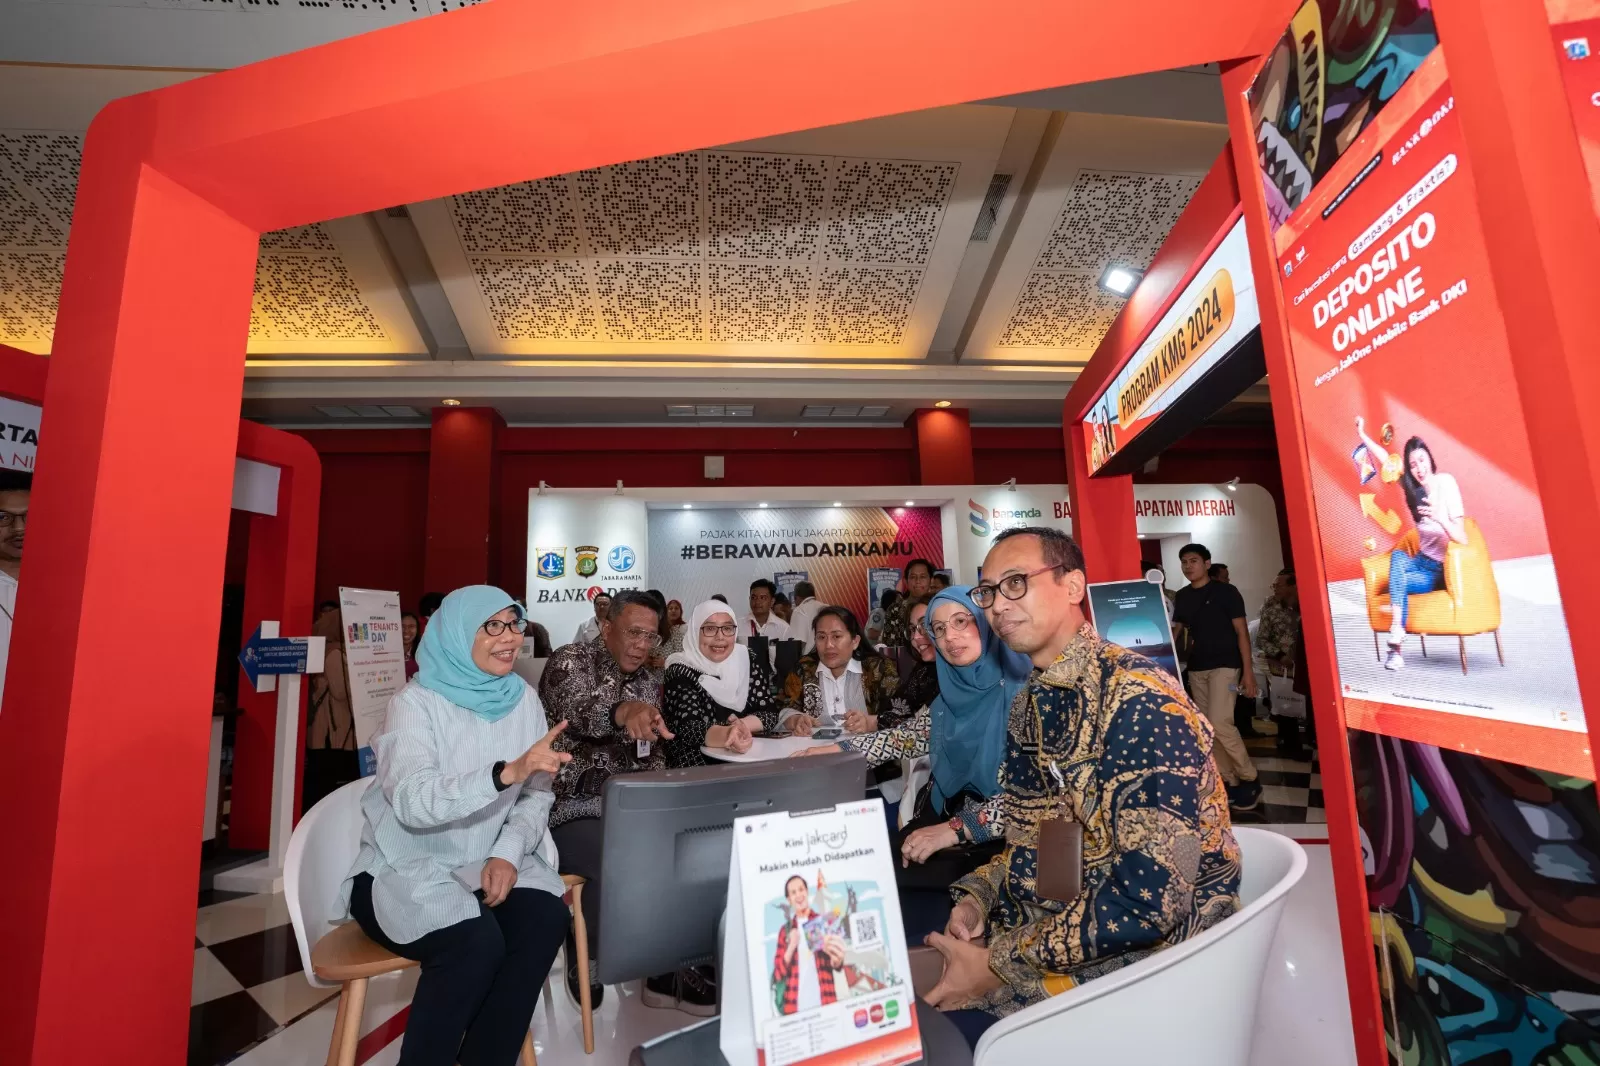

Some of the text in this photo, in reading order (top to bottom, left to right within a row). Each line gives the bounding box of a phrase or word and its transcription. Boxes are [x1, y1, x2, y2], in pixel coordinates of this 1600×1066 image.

[1351, 213, 1395, 255] Gampang
[1312, 212, 1436, 329] DEPOSITO
[1331, 265, 1426, 352] ONLINE
[1372, 321, 1408, 350] Mobile
[1408, 299, 1441, 327] Bank
[1441, 279, 1468, 306] DKI
[1121, 287, 1222, 421] PROGRAM KMG 2024
[992, 507, 1041, 521] bapenda
[1135, 499, 1183, 518] APATAN
[1186, 499, 1236, 517] DAERAH
[700, 527, 896, 539] PAJAK KITA UNTUK JAKARTA GLOBAL
[680, 542, 914, 560] #BERAWALDARIKAMU
[536, 588, 588, 604] BANK
[369, 622, 399, 632] TENANTS
[371, 632, 387, 643] DAY
[784, 837, 804, 849] Kini
[759, 847, 875, 873] Makin Mudah Didapatkan
